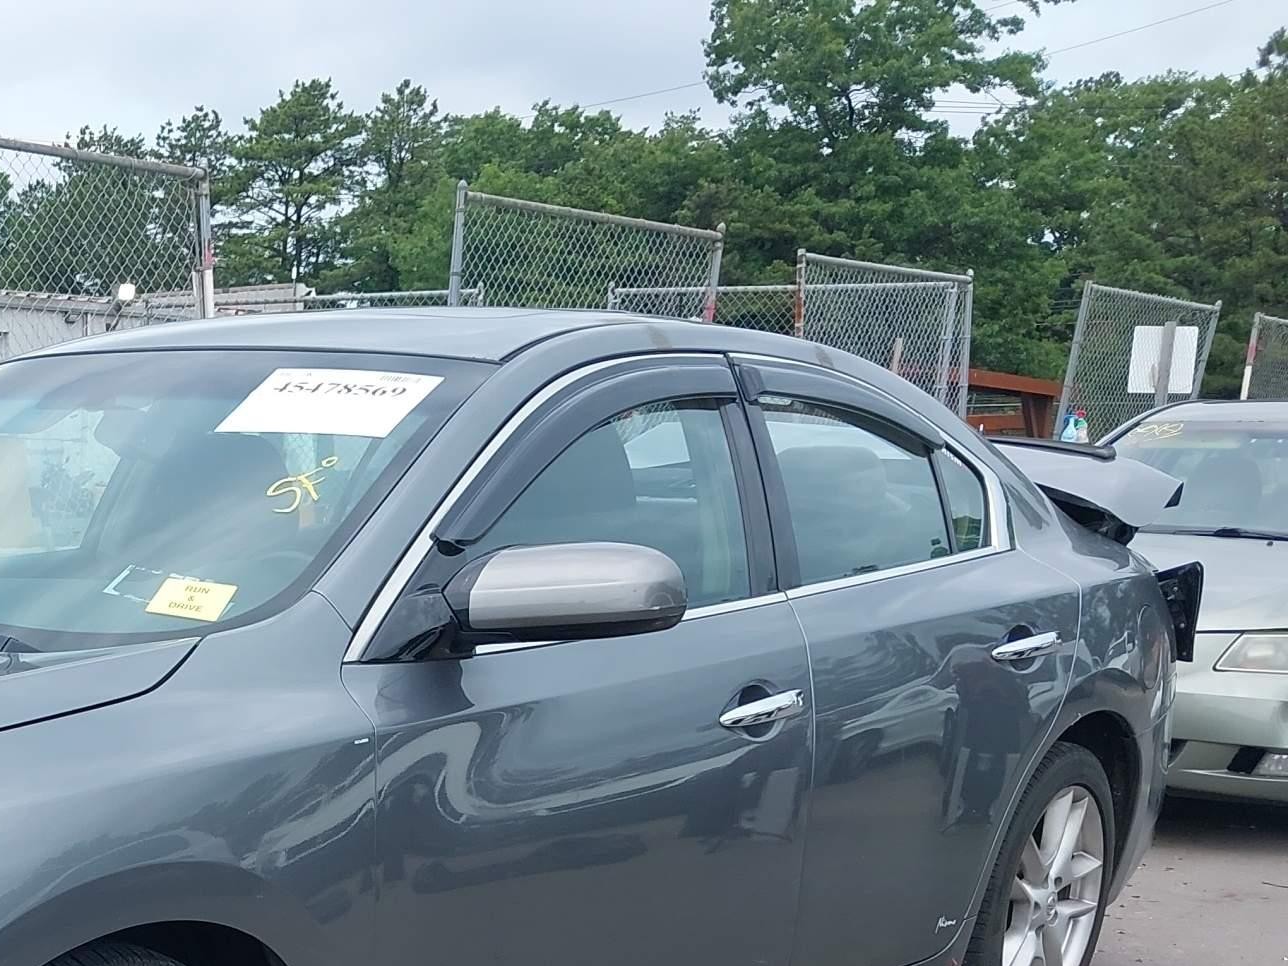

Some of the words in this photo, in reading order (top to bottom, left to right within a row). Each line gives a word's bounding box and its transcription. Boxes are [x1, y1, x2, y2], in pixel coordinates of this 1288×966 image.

[273, 381, 408, 397] 45478569
[184, 584, 210, 594] RUN
[168, 601, 203, 612] DRIVE
